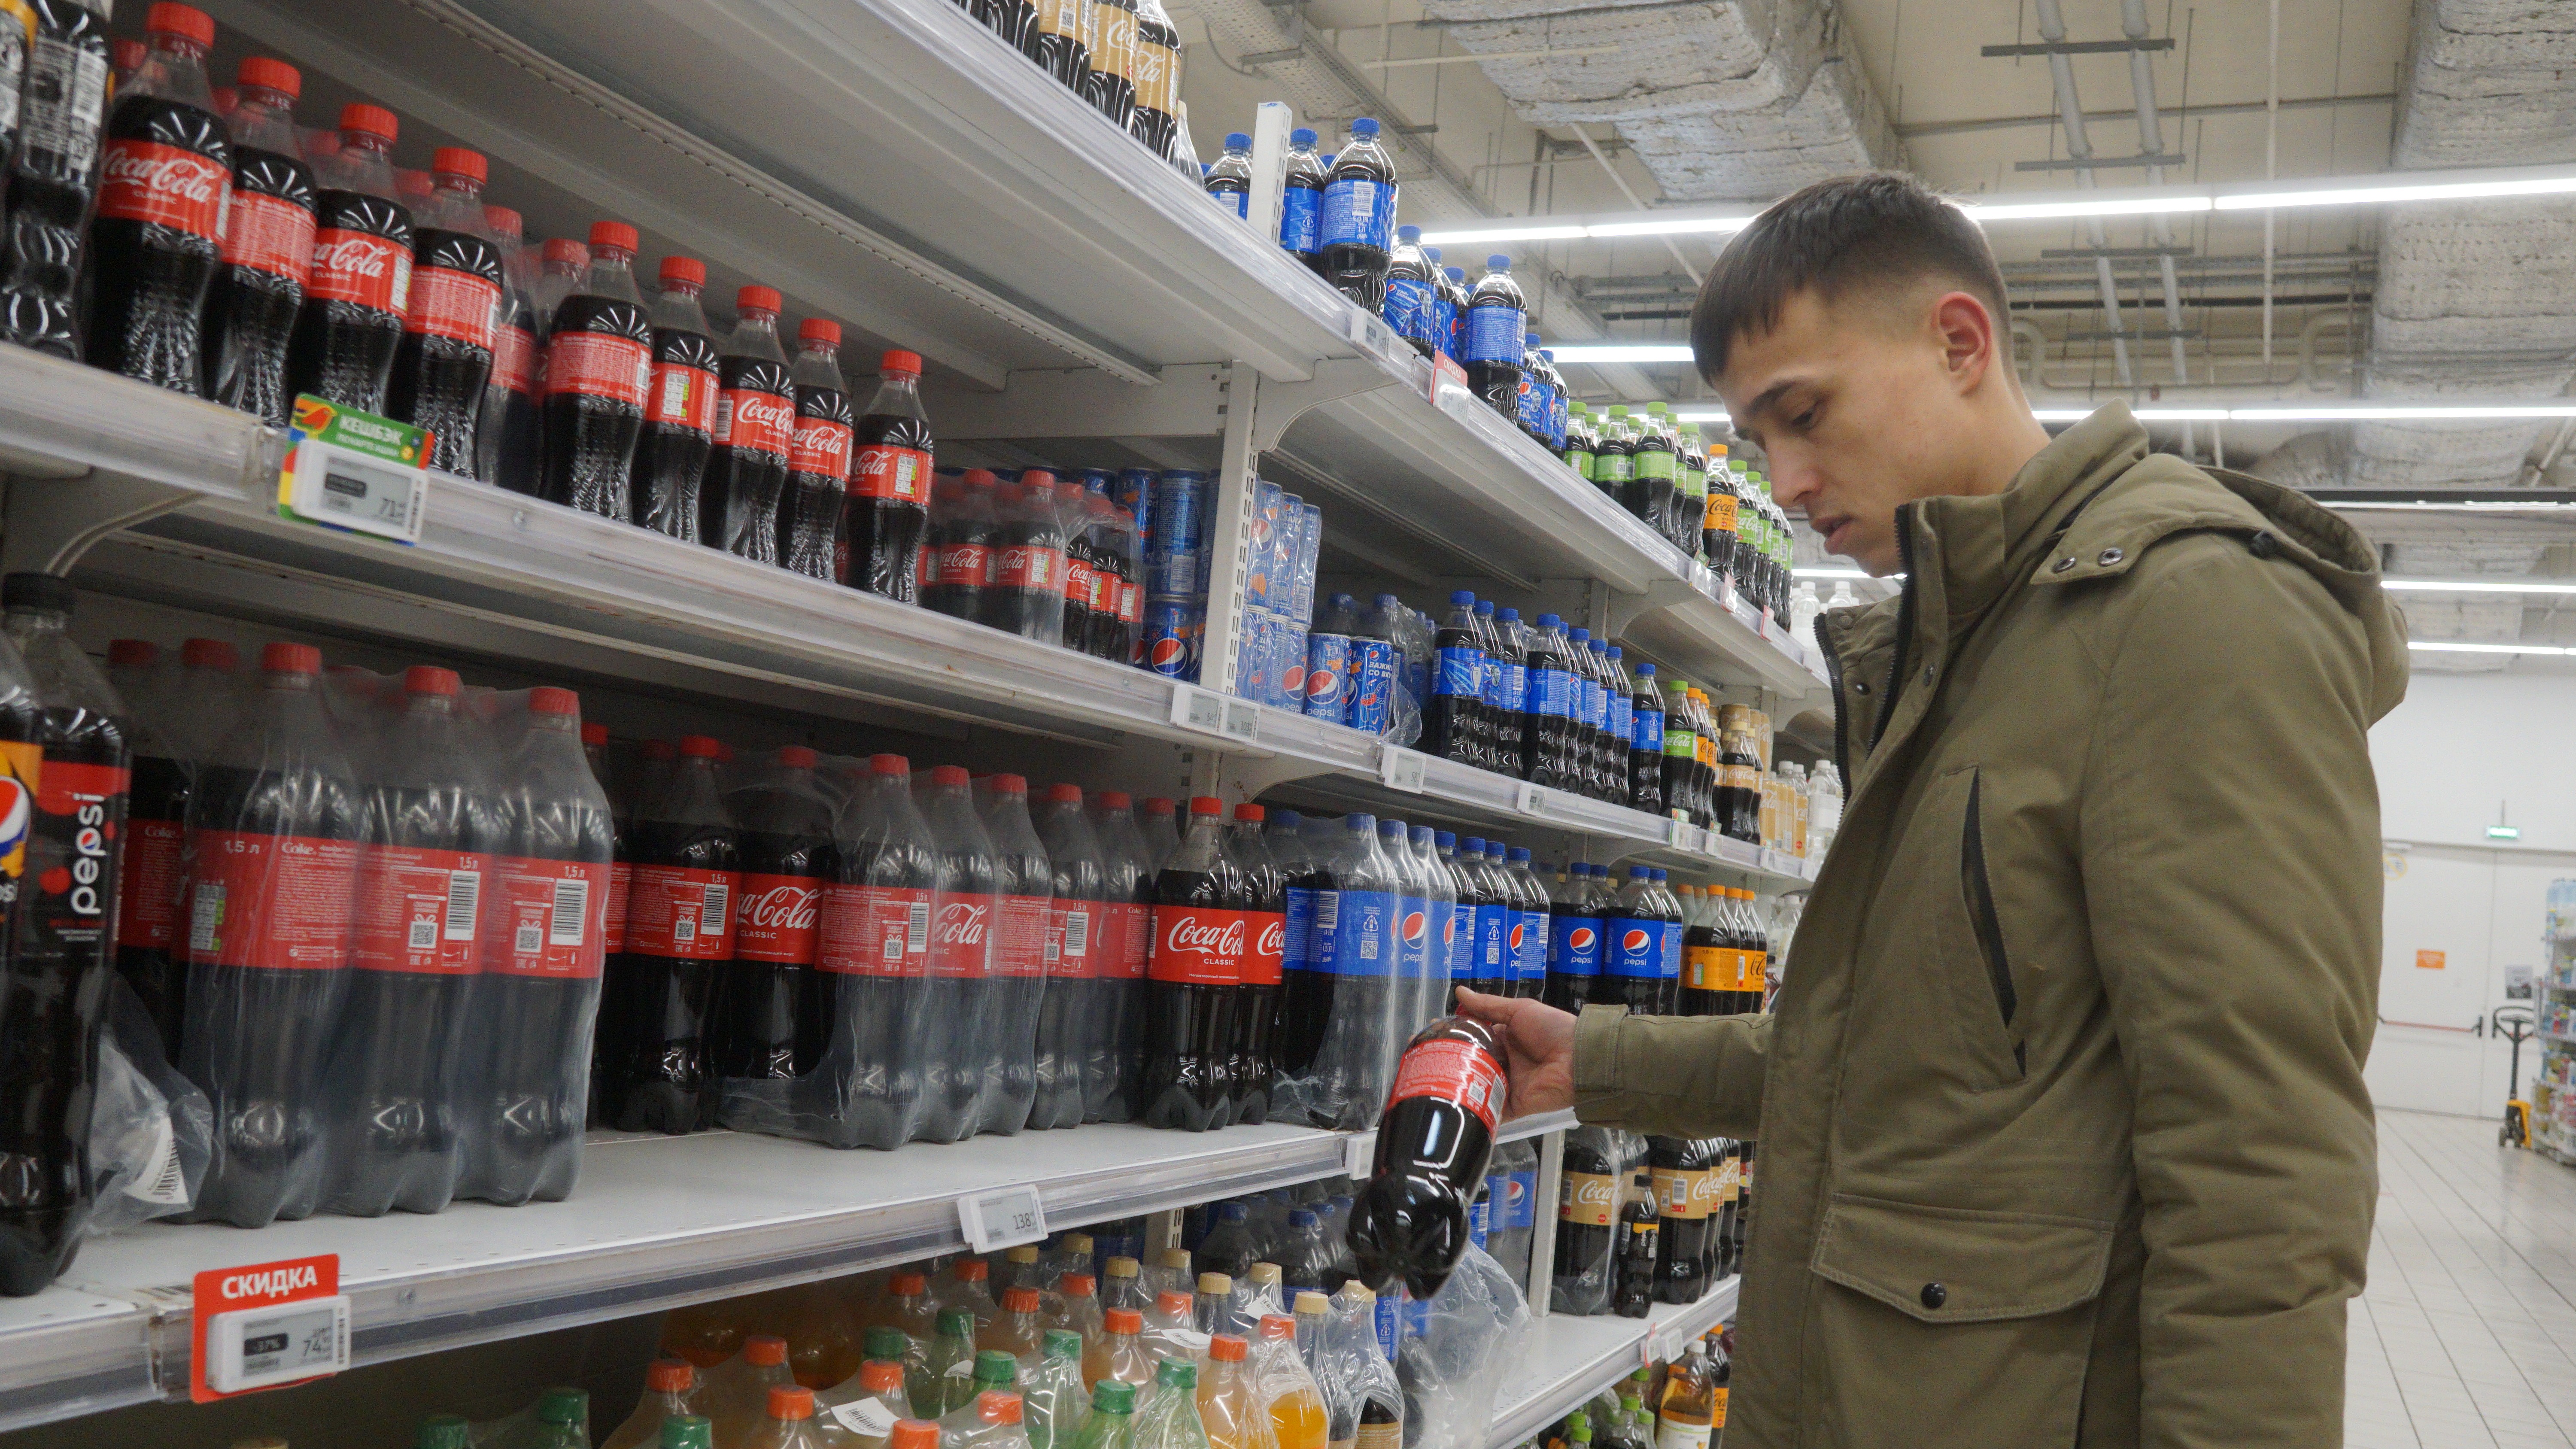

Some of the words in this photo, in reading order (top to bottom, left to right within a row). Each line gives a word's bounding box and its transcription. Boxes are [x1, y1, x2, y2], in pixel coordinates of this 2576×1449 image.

[1443, 358, 1461, 380] СКИДКА
[794, 450, 822, 458] CLASSIC
[1368, 662, 1392, 671] ЗАЖИГ
[1306, 708, 1335, 719] pepsi
[70, 792, 106, 914] pepsi
[564, 866, 578, 879] 1,5
[711, 873, 722, 884] 1,5
[738, 886, 822, 930] a-Cola
[1073, 902, 1081, 911] 1,5
[1128, 906, 1142, 914] Coke
[740, 930, 777, 939] CLASSIC
[1168, 916, 1245, 956] Coca-Col
[1571, 956, 1593, 965] pepsi
[1624, 958, 1647, 967] pepsi
[1013, 1213, 1032, 1230] 138
[221, 1265, 318, 1299] СКИДКА
